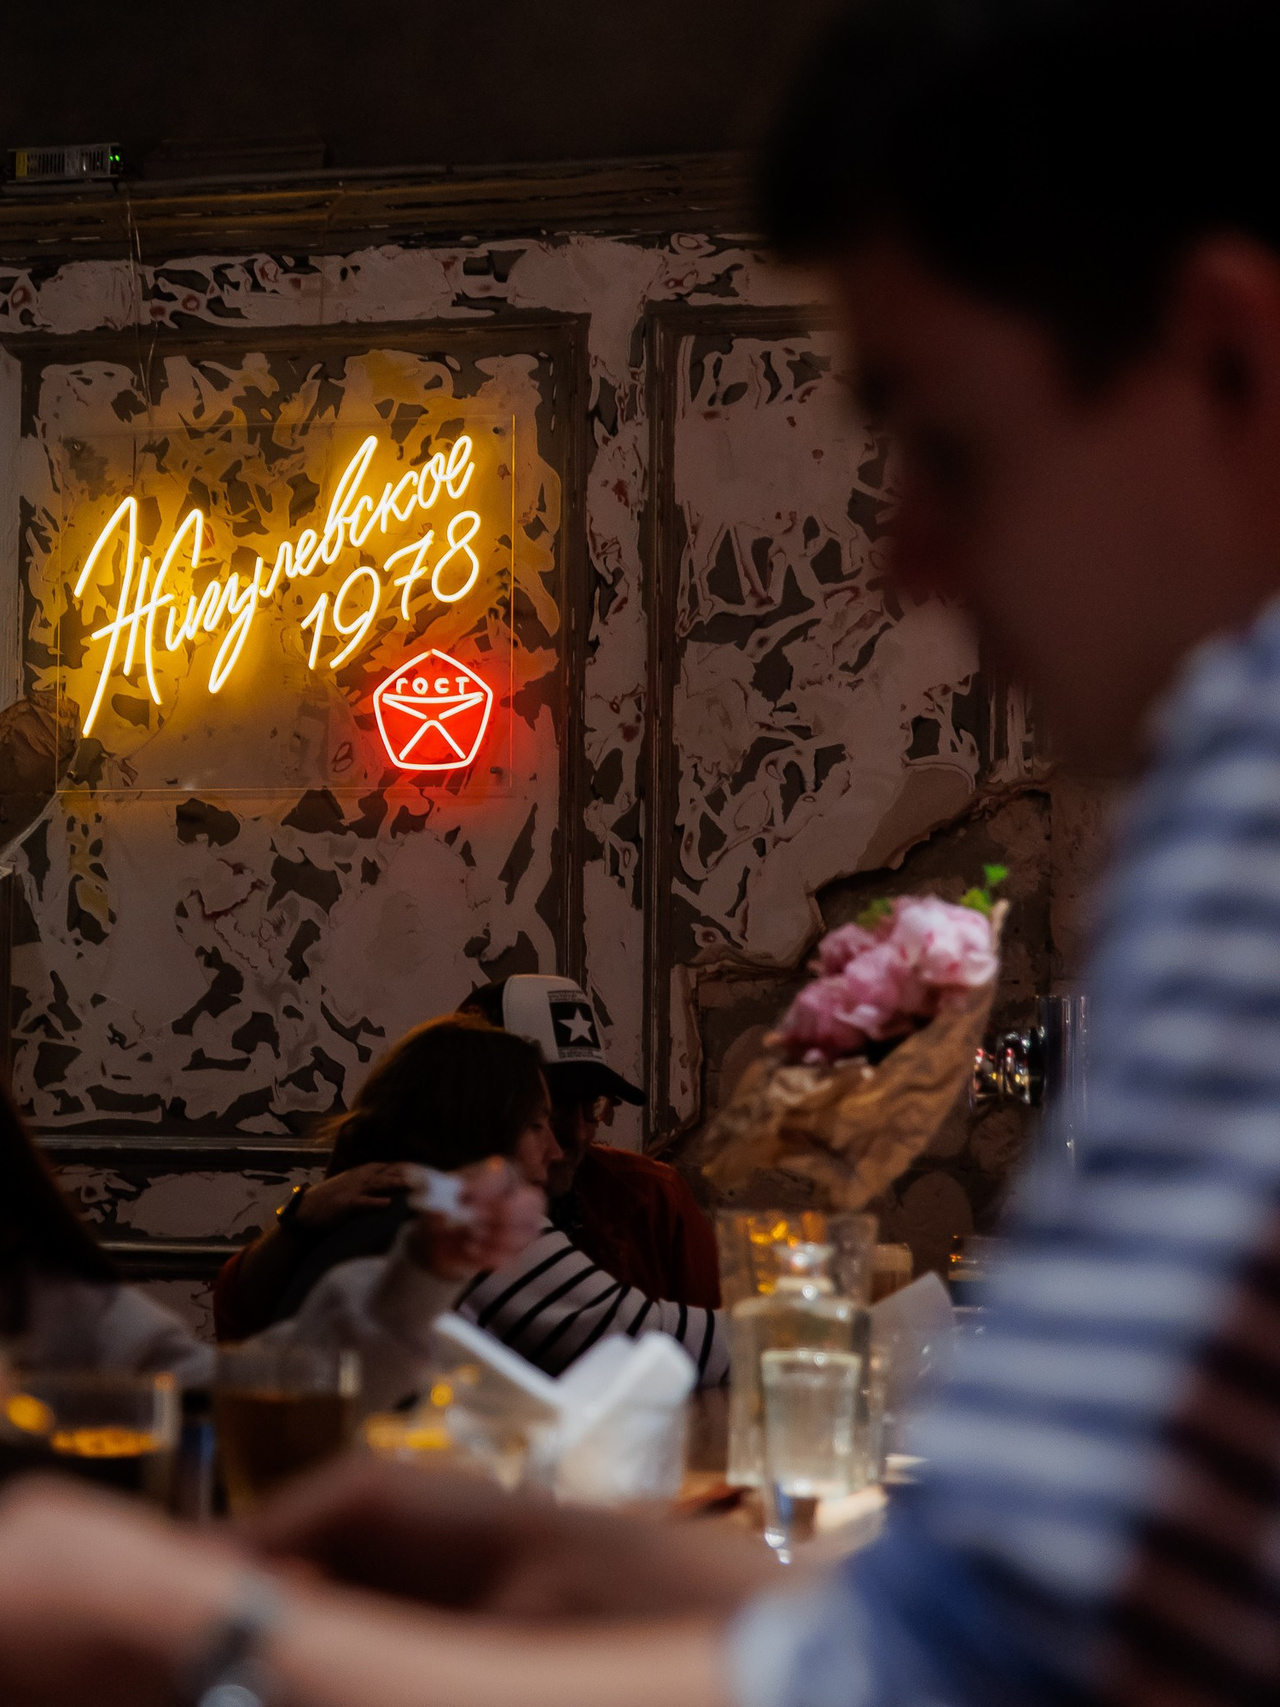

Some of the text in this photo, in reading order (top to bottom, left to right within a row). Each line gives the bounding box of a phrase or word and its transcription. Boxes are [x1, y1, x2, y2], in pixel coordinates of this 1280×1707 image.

[73, 434, 476, 738] Жигулевское
[300, 510, 482, 671] 1978
[395, 676, 470, 695] ГОСТ
